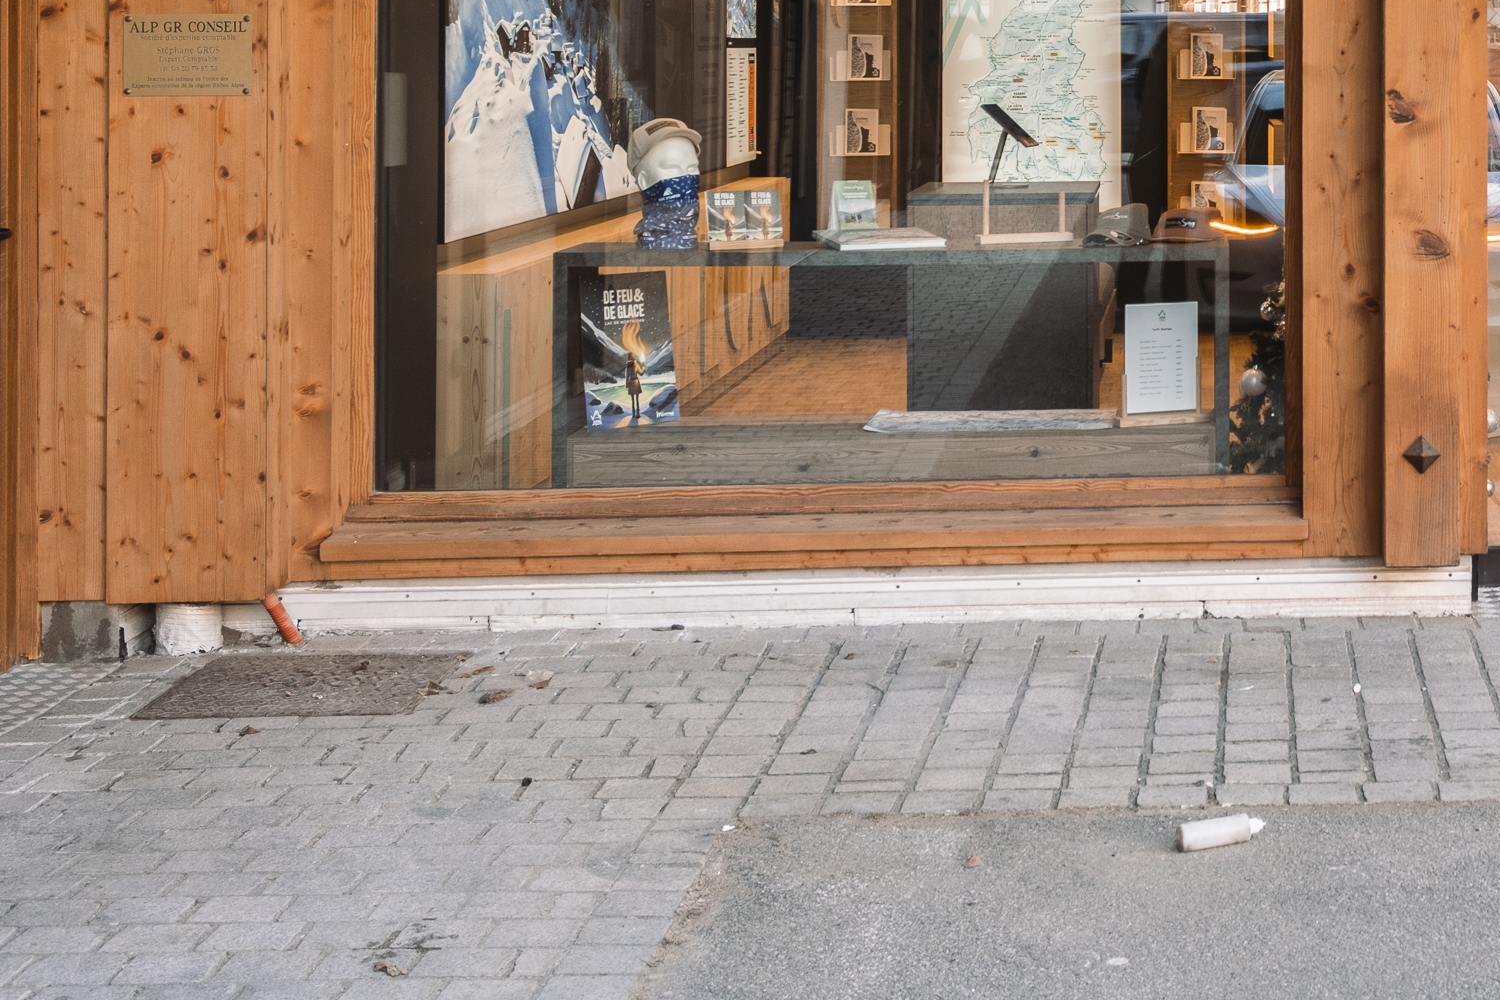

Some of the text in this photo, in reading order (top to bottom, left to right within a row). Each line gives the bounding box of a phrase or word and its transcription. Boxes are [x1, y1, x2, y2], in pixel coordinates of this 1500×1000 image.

[130, 21, 247, 33] ALP GR CONSEIL
[202, 34, 237, 42] comptable
[157, 46, 221, 55] Stéphane GROS
[603, 288, 644, 304] DE FEU &
[604, 303, 645, 320] DE GLACE
